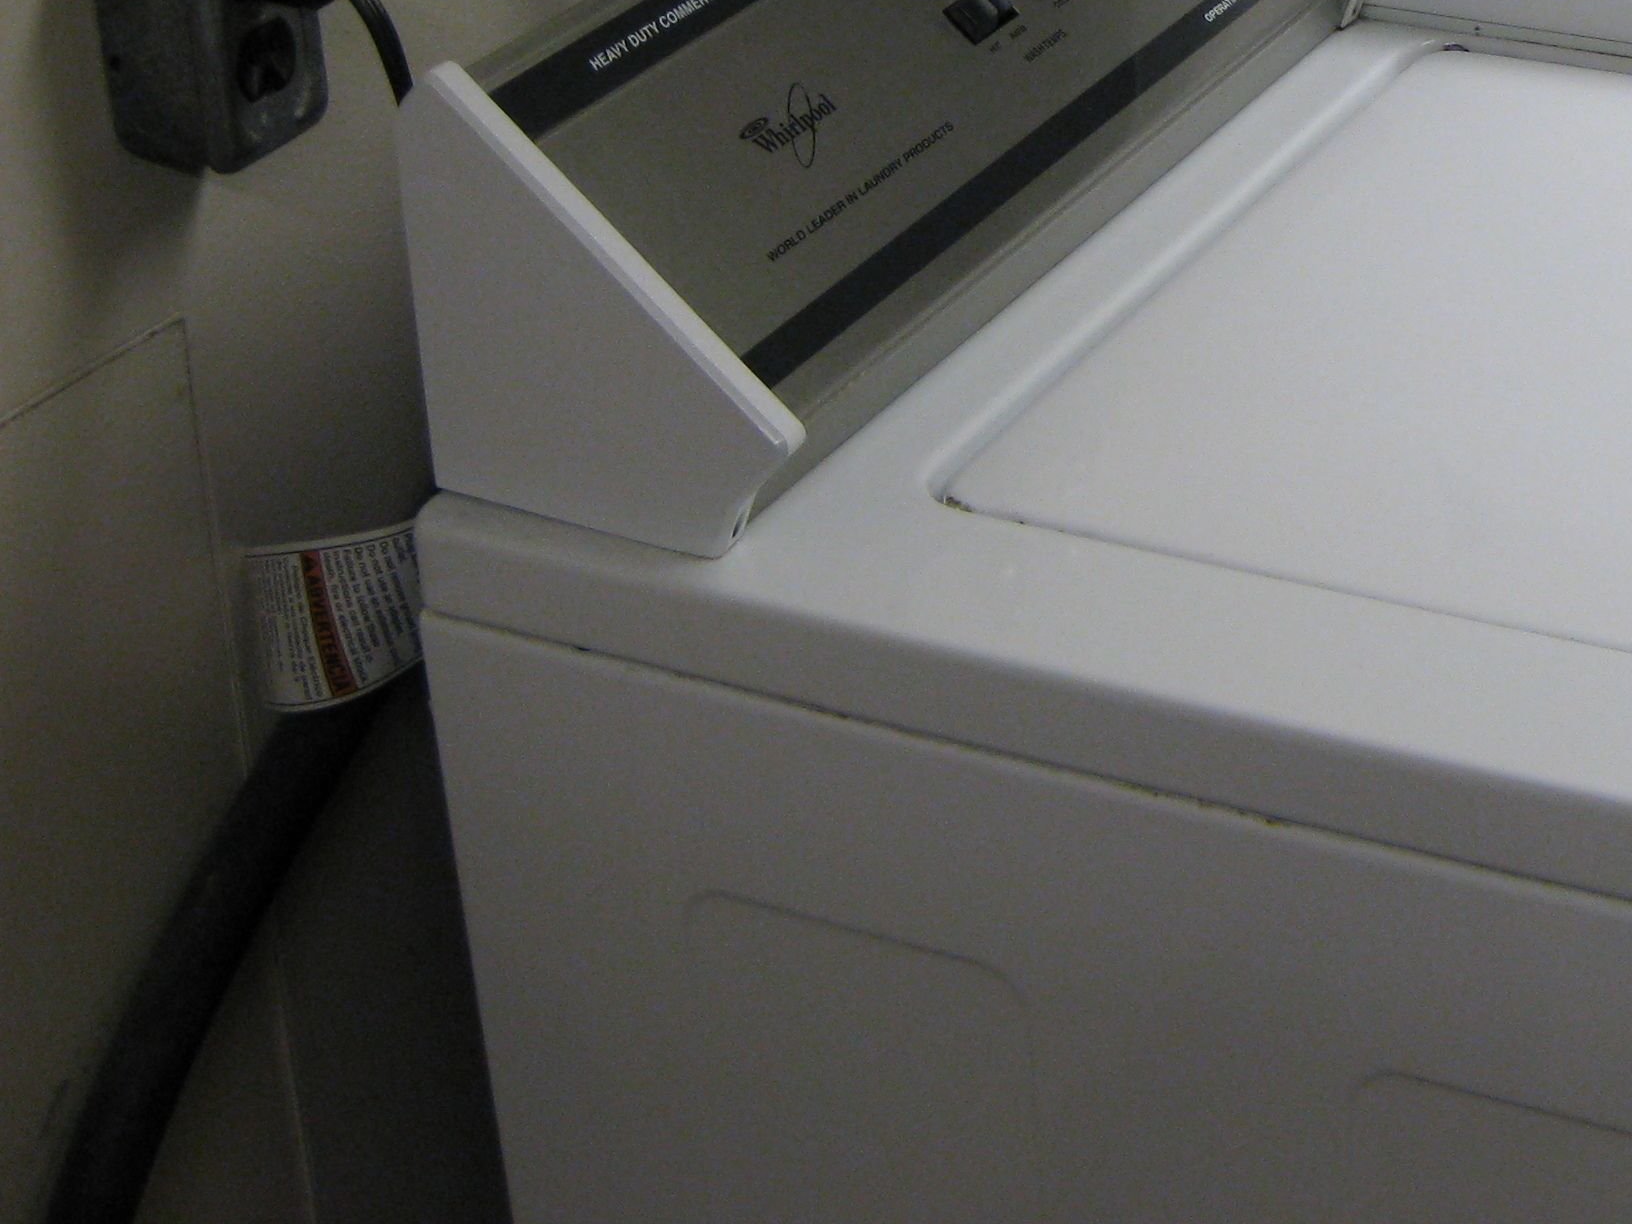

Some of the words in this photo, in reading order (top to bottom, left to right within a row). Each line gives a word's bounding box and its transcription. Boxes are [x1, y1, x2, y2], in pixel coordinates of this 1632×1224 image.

[589, 38, 628, 72] HEAVY
[629, 20, 661, 48] DUTY
[751, 92, 838, 155] Whirlpool
[766, 229, 807, 263] WORLD
[806, 200, 848, 235] LEADER
[845, 193, 859, 206] IN
[857, 158, 904, 197] LAUNDRY
[902, 120, 955, 163] PRODUCTS
[354, 547, 364, 561] Do
[359, 563, 371, 577] not
[367, 544, 376, 557] Do
[373, 560, 384, 574] not
[308, 576, 348, 692] ADVERTENCIA
[358, 595, 371, 622] follow
